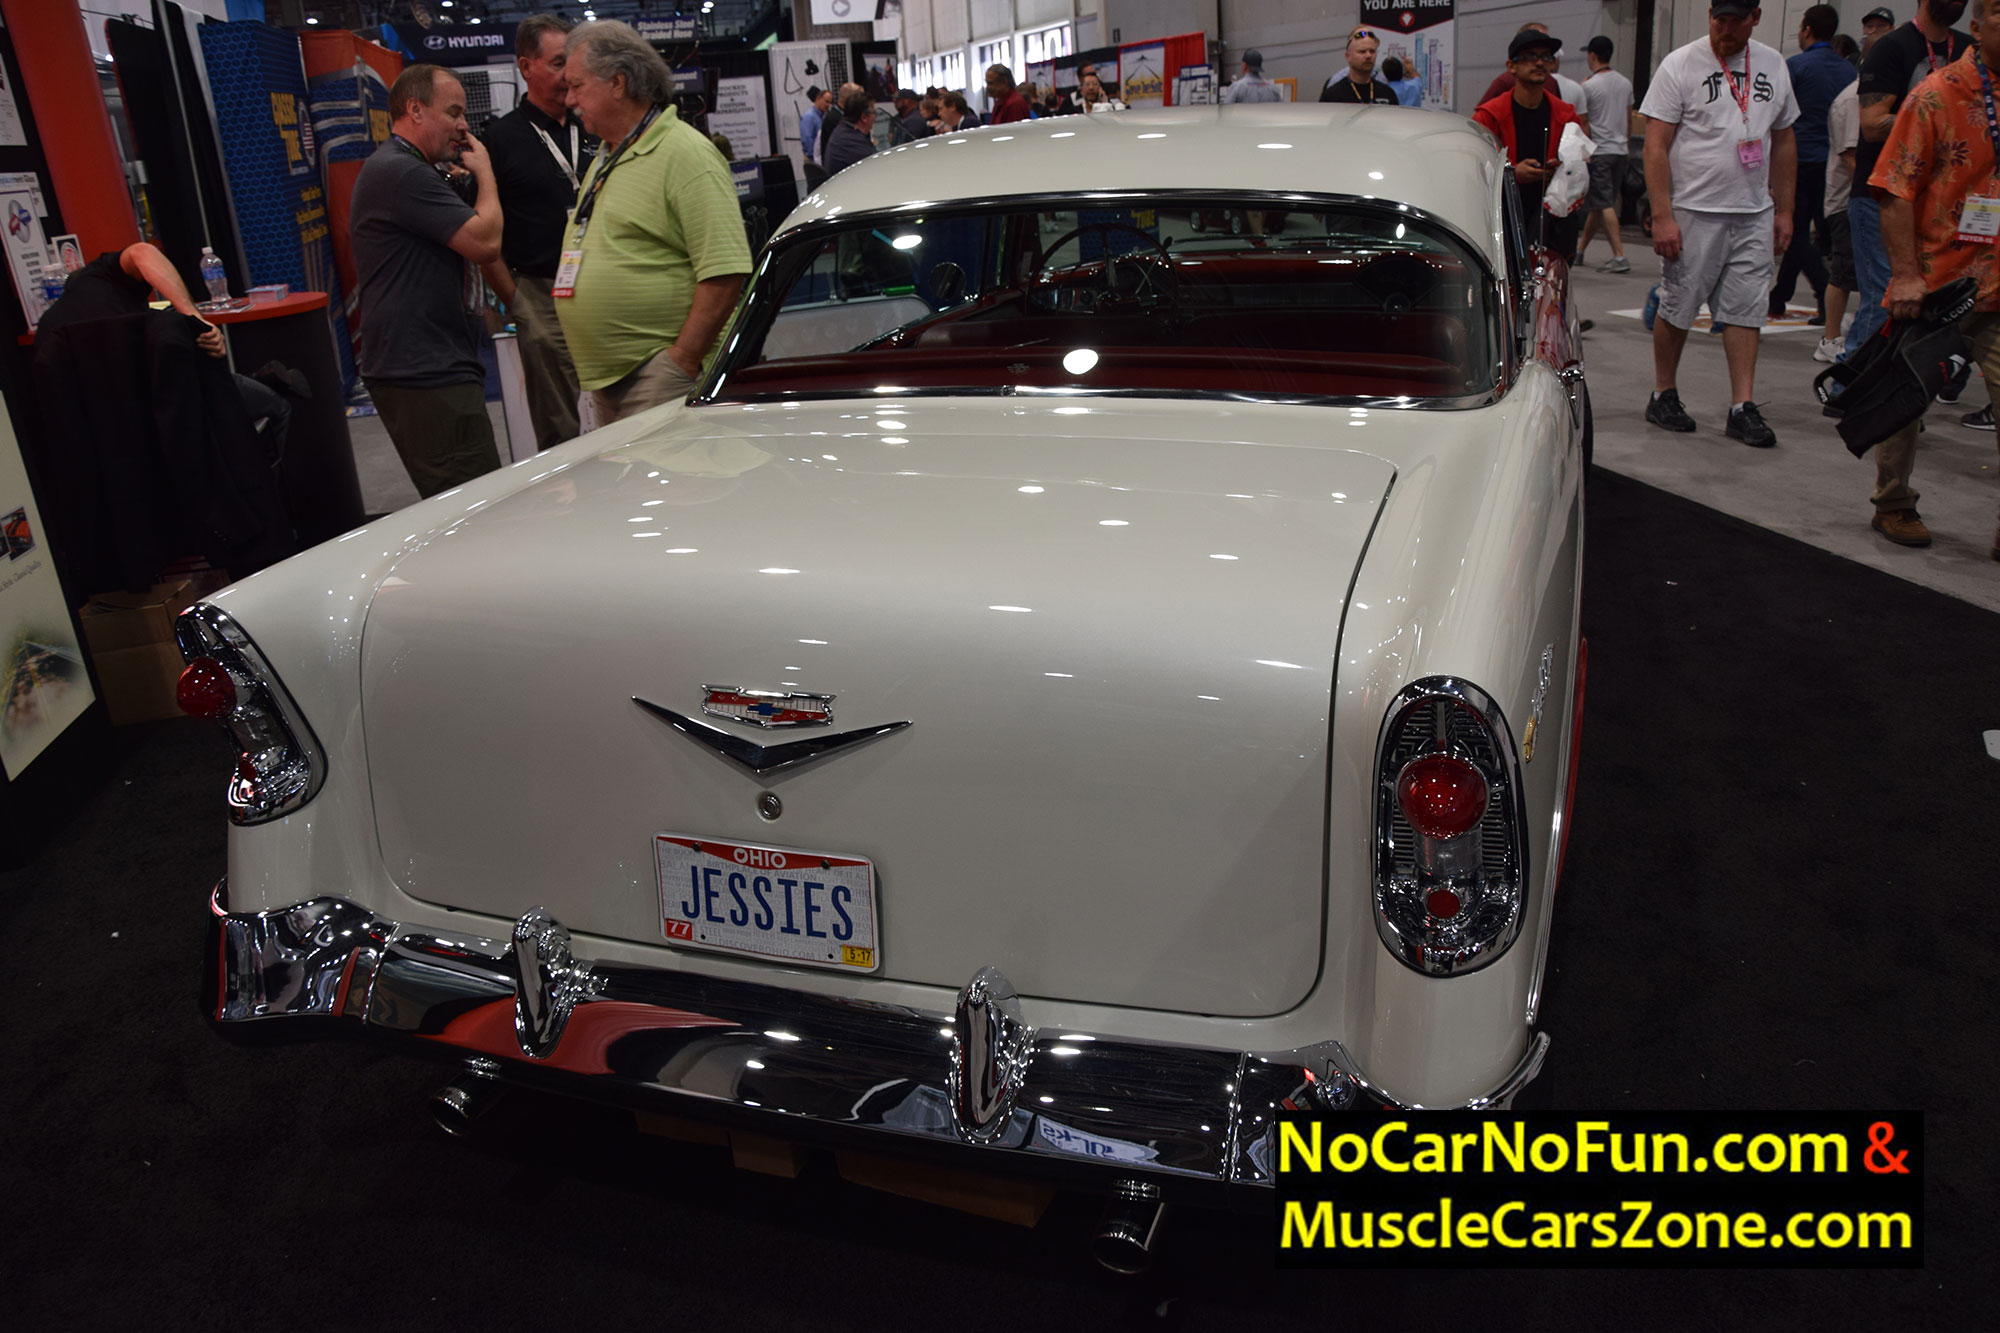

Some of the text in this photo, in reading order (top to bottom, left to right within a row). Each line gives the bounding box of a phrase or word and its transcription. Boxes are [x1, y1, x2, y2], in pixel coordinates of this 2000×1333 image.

[1364, 0, 1389, 10] YOU
[1392, 0, 1416, 8] ARE
[674, 19, 695, 29] Steel
[448, 35, 504, 49] HYUNDAI
[733, 847, 787, 869] OHIO
[681, 865, 854, 941] JESSIES
[668, 920, 691, 936] 77
